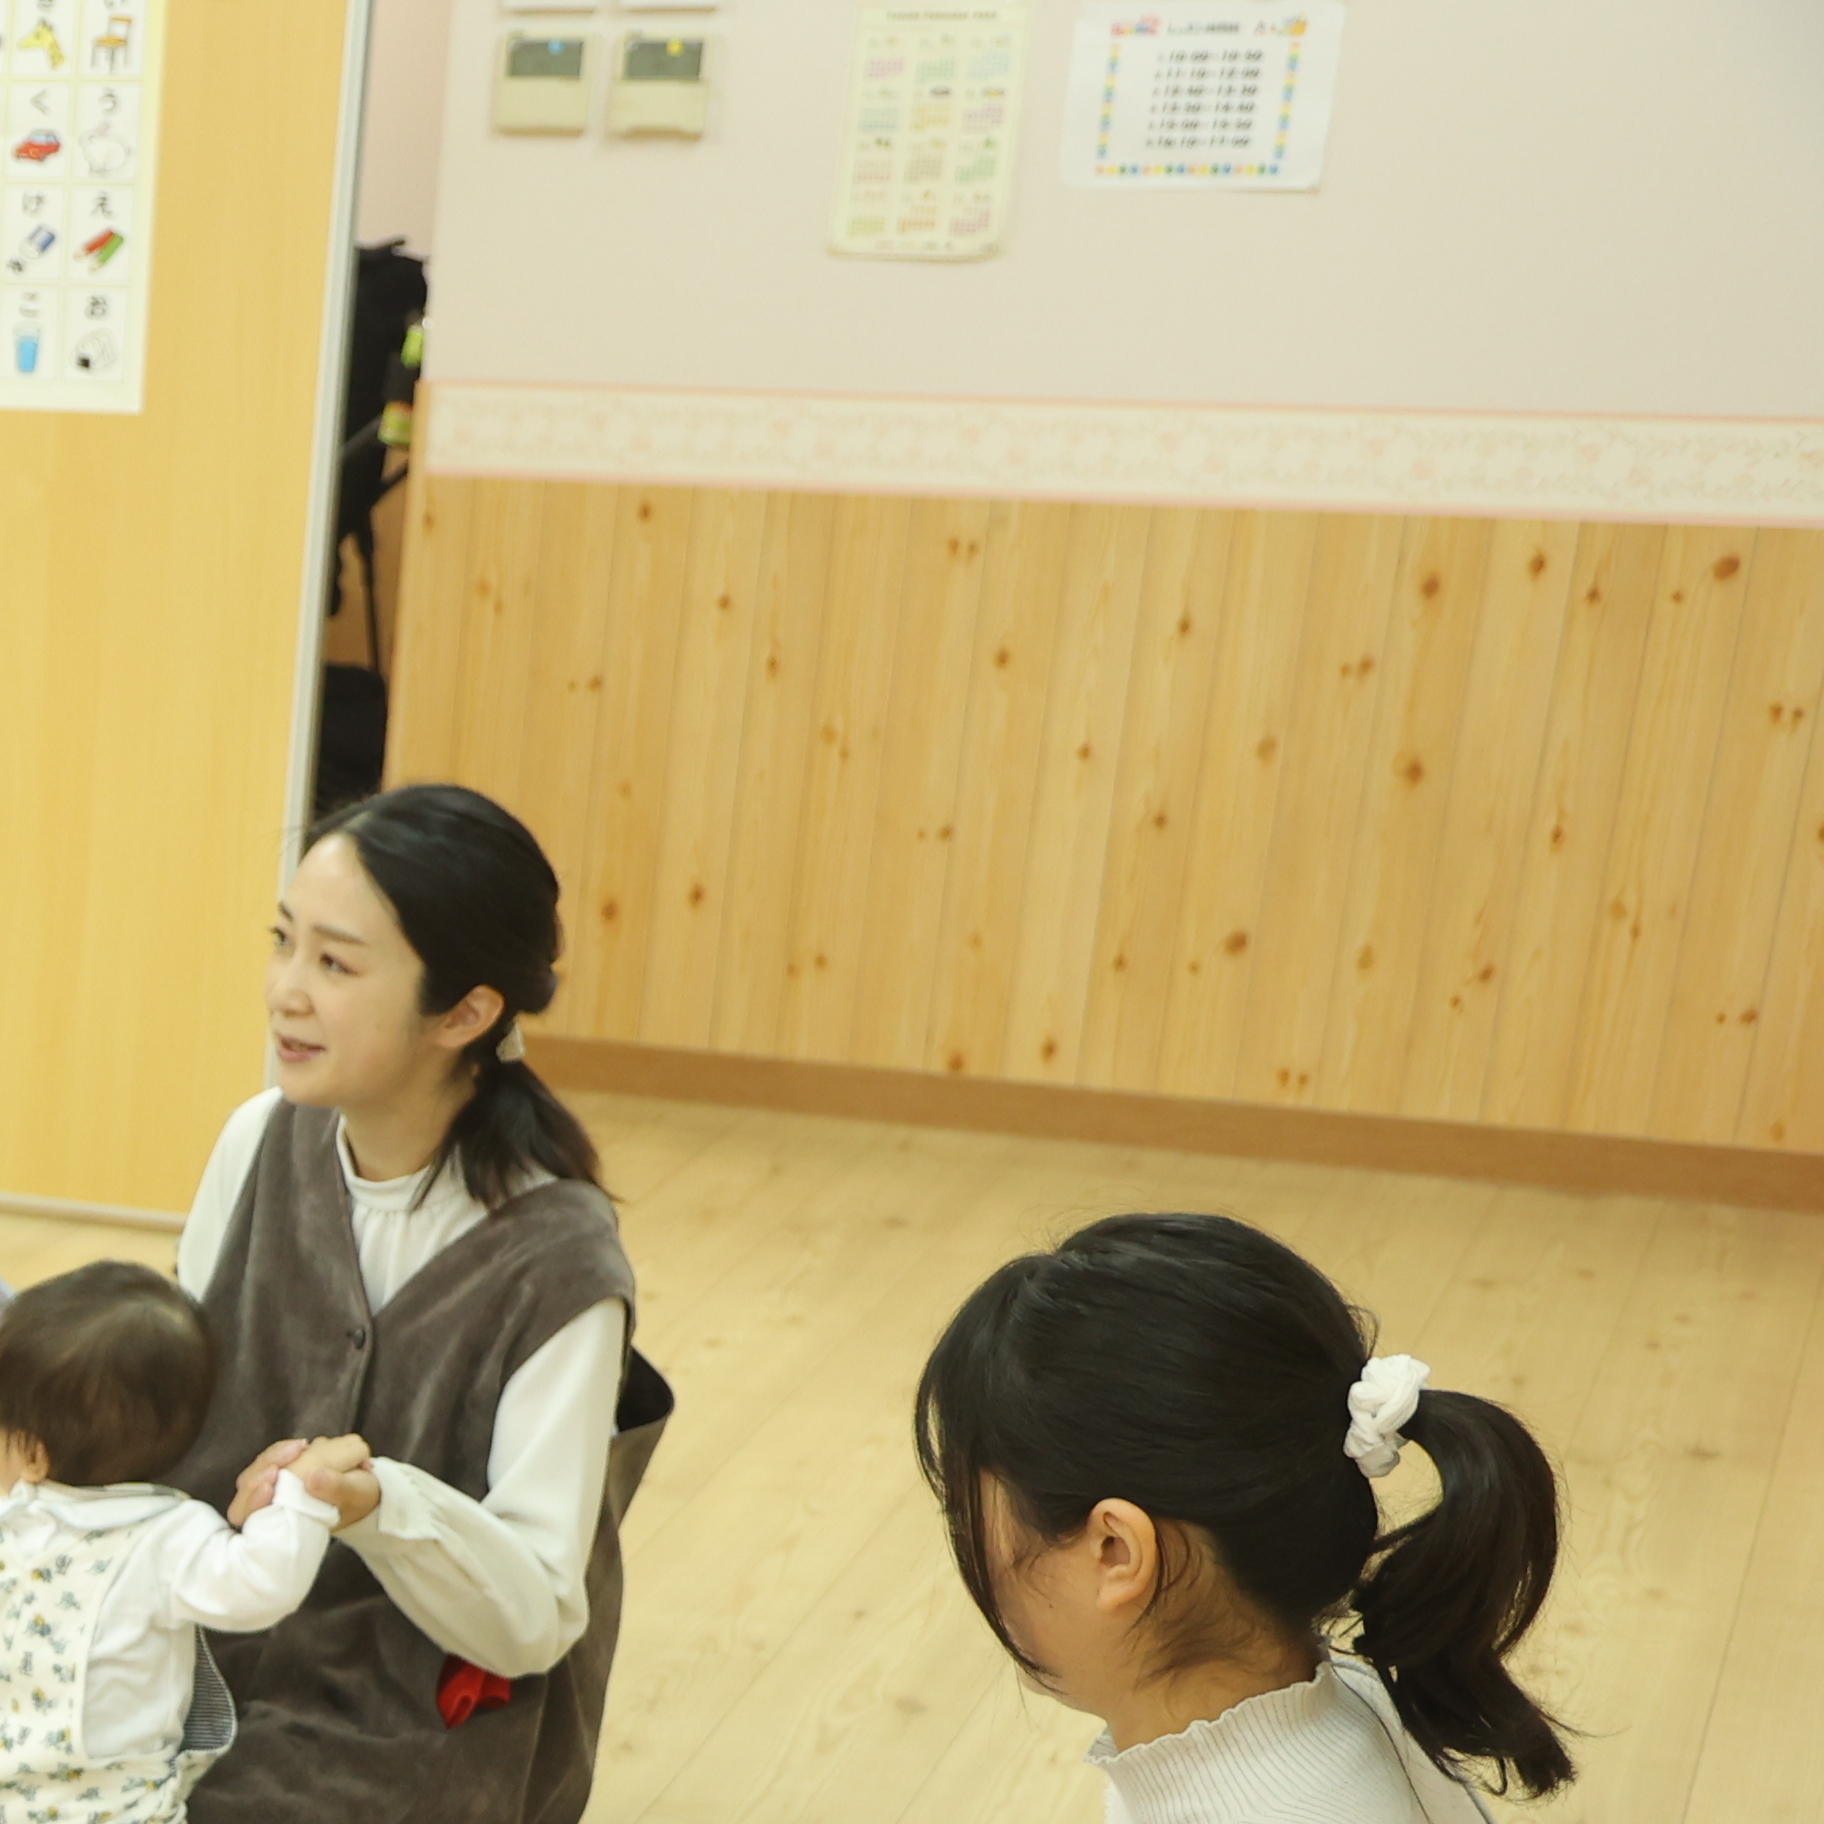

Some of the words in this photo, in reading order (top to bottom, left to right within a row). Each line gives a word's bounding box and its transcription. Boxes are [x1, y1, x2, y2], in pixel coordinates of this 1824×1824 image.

[30, 90, 47, 114] く
[100, 89, 118, 114] う
[92, 190, 114, 219] え
[19, 292, 40, 318] こ
